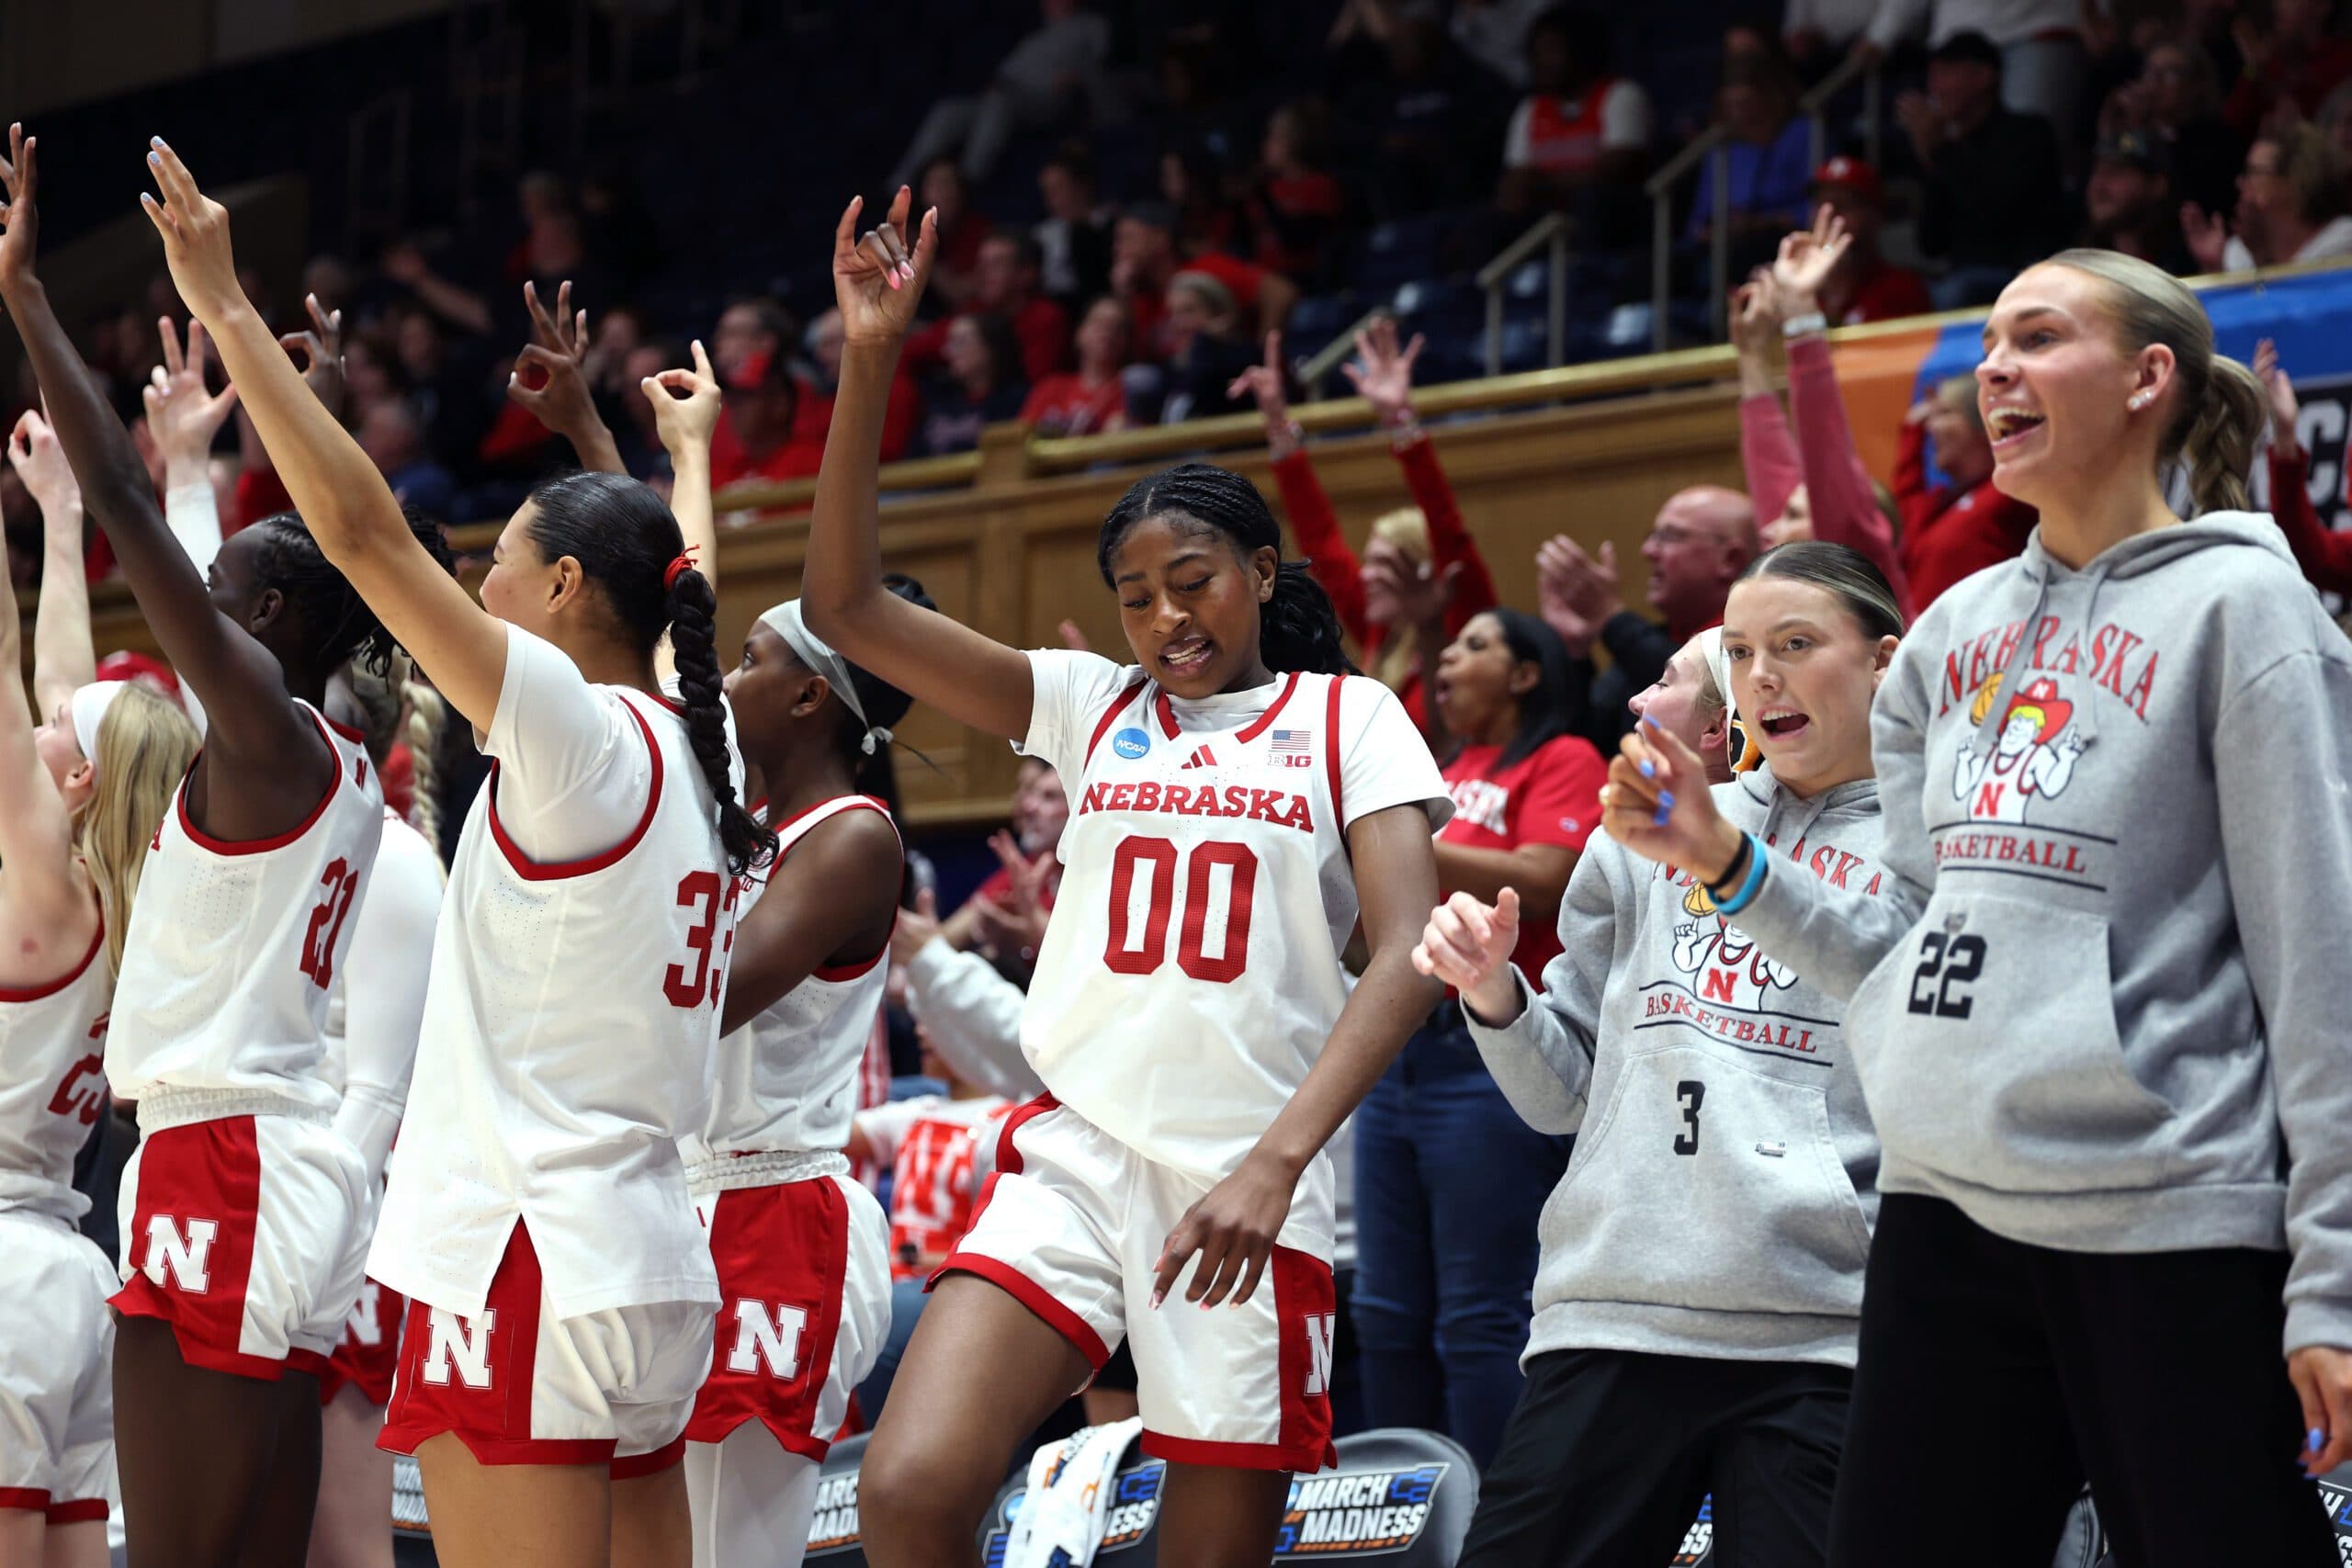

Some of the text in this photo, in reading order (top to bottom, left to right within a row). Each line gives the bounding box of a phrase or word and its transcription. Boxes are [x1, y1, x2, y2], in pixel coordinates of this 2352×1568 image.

[1939, 615, 2159, 725] NEBRASKA
[2032, 680, 2050, 696] N
[1116, 739, 1148, 753] NCAA
[1079, 782, 1315, 833] NEBRASKA
[1973, 783, 2005, 817] N
[300, 856, 358, 991] 21
[1102, 835, 1258, 984] 00
[1702, 967, 1738, 1003] N
[1907, 931, 1987, 1020] 22
[1645, 992, 1817, 1054] BASKETBALL
[1673, 1080, 1706, 1156] 3
[141, 1214, 219, 1294] N
[422, 1306, 497, 1389] N
[727, 1298, 808, 1382] N
[1304, 1312, 1335, 1396] N
[1294, 1474, 1392, 1511] MARCH
[1299, 1504, 1427, 1543] MADNESS
